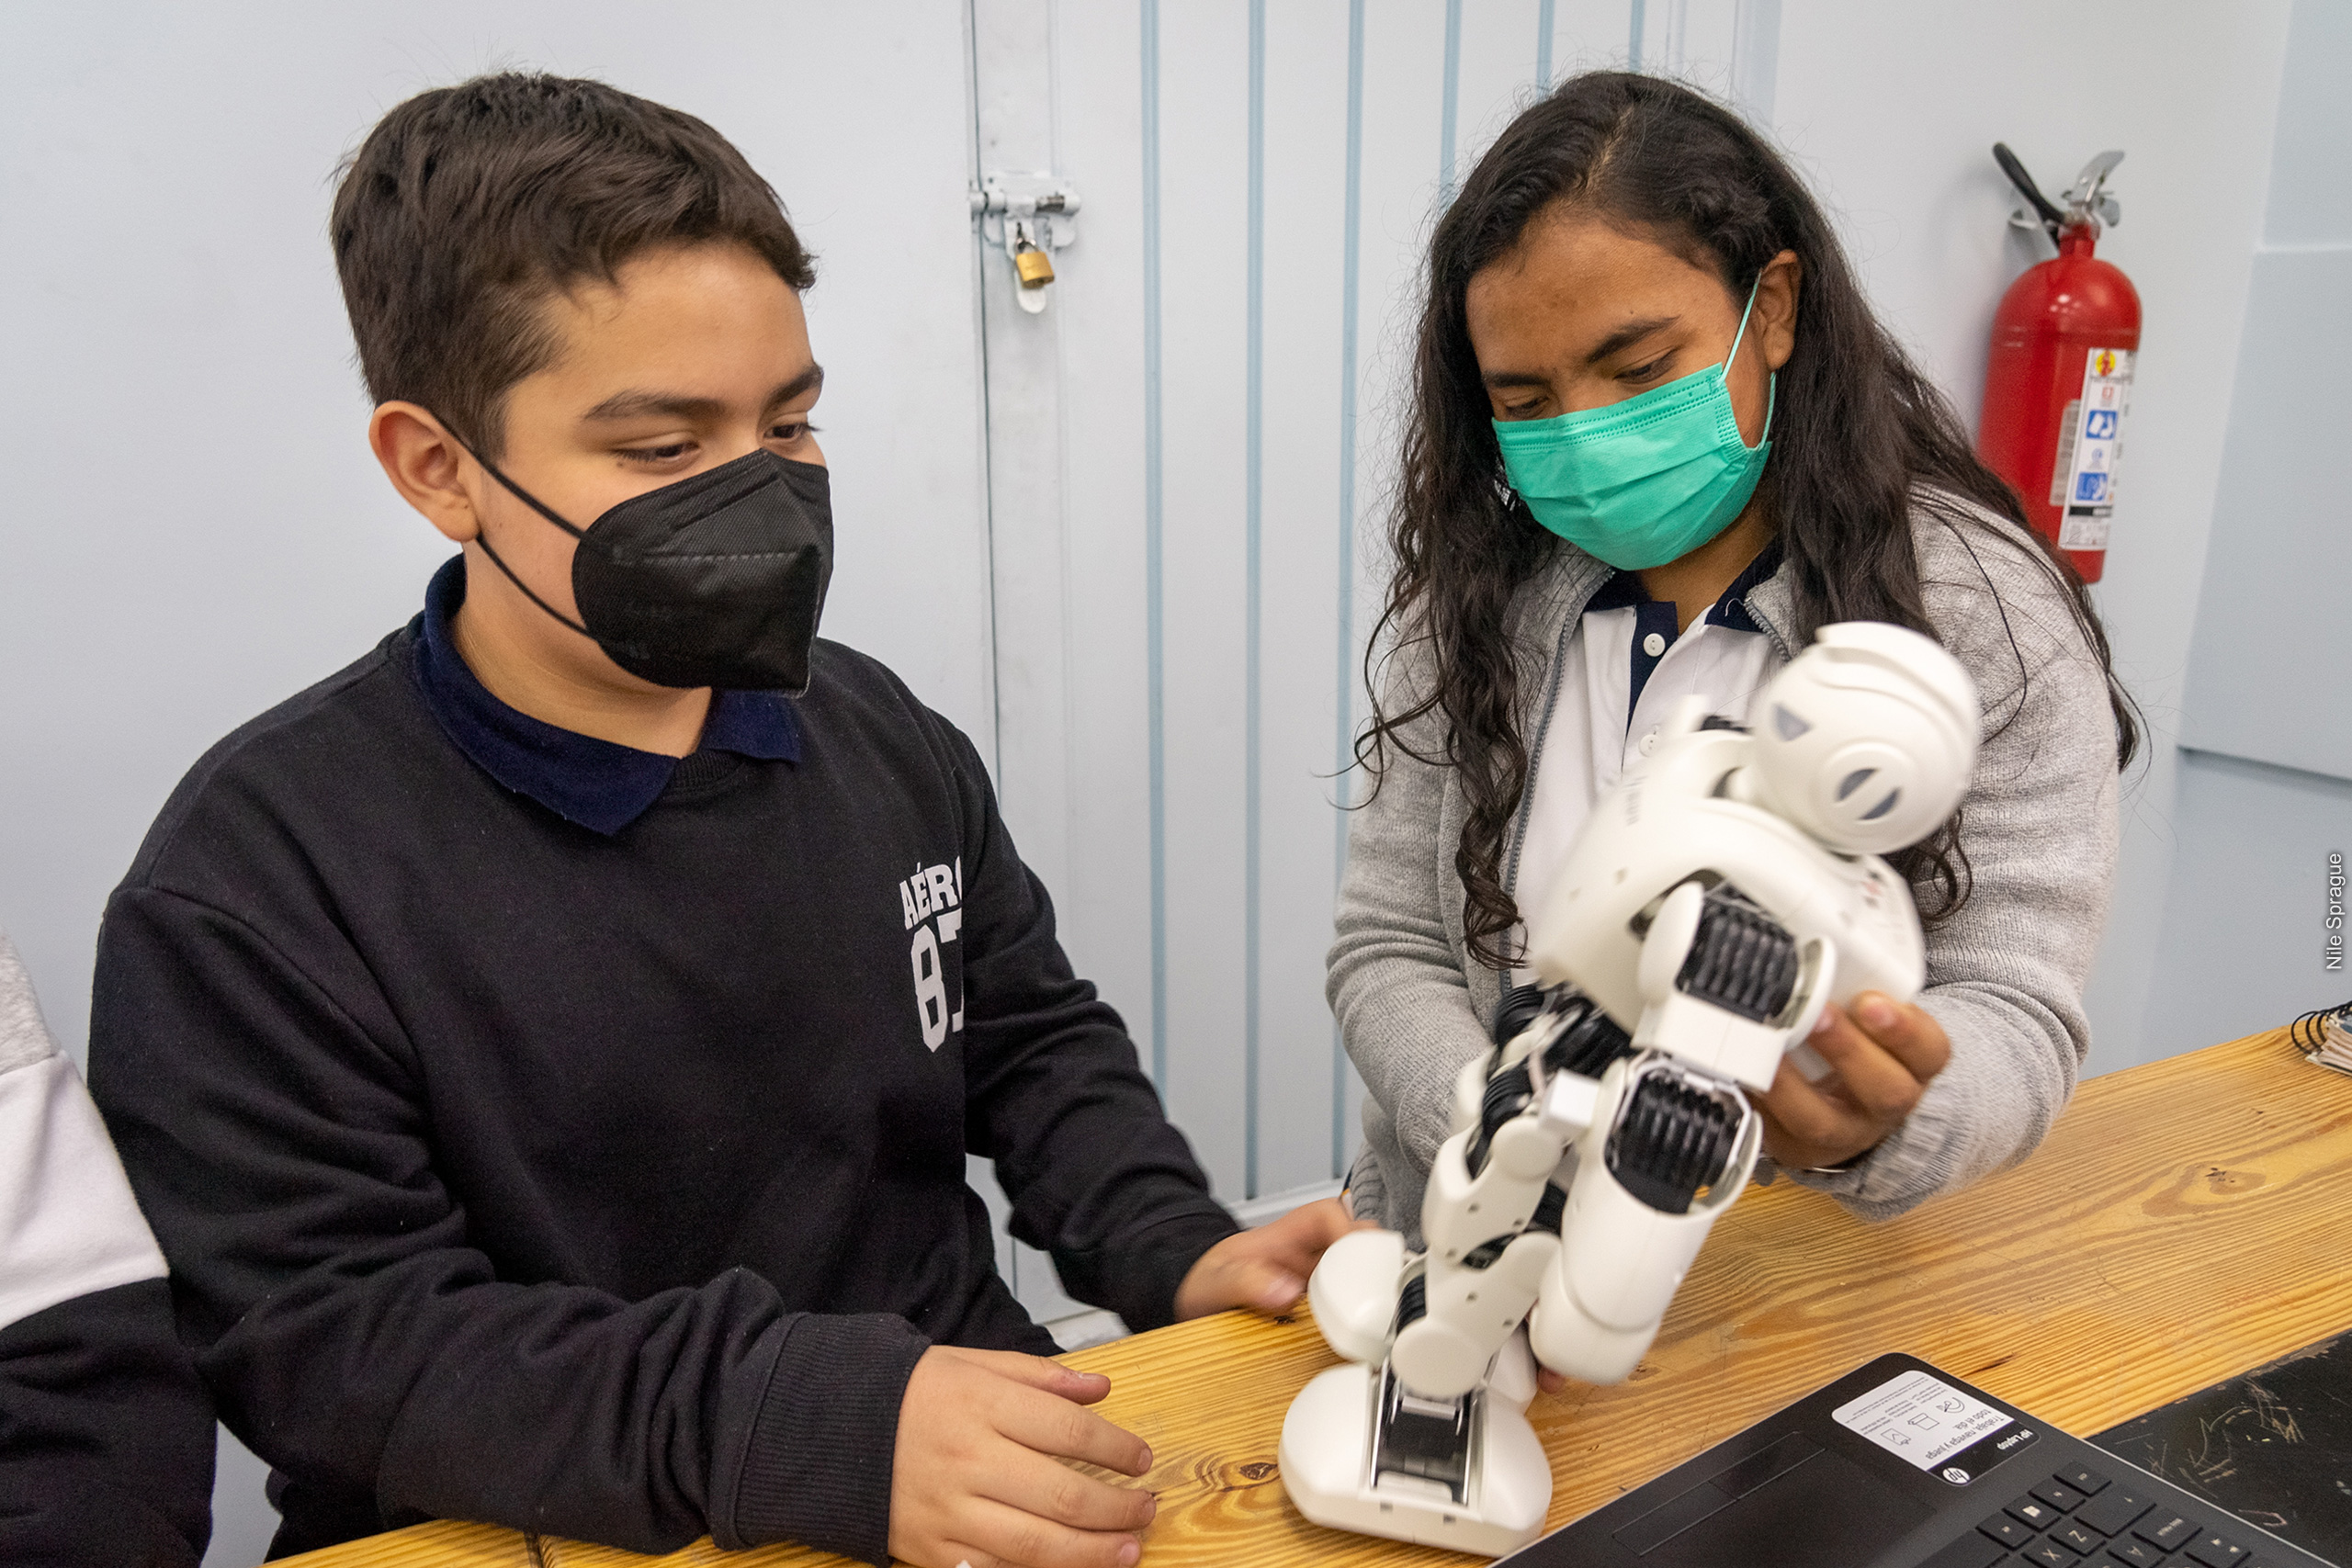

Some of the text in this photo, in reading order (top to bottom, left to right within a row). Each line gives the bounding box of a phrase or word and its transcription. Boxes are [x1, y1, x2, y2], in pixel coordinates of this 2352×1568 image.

[899, 856, 963, 930] AÉR
[1973, 1408, 1992, 1420] todo
[1965, 1417, 1975, 1426] el
[1950, 1429, 1976, 1446] navega
[1996, 1428, 2033, 1450] HP Laptop
[1926, 1445, 1949, 1460] juega
[2069, 1529, 2087, 1543] Z
[2042, 1549, 2062, 1561] X
[2127, 1545, 2144, 1557] A
